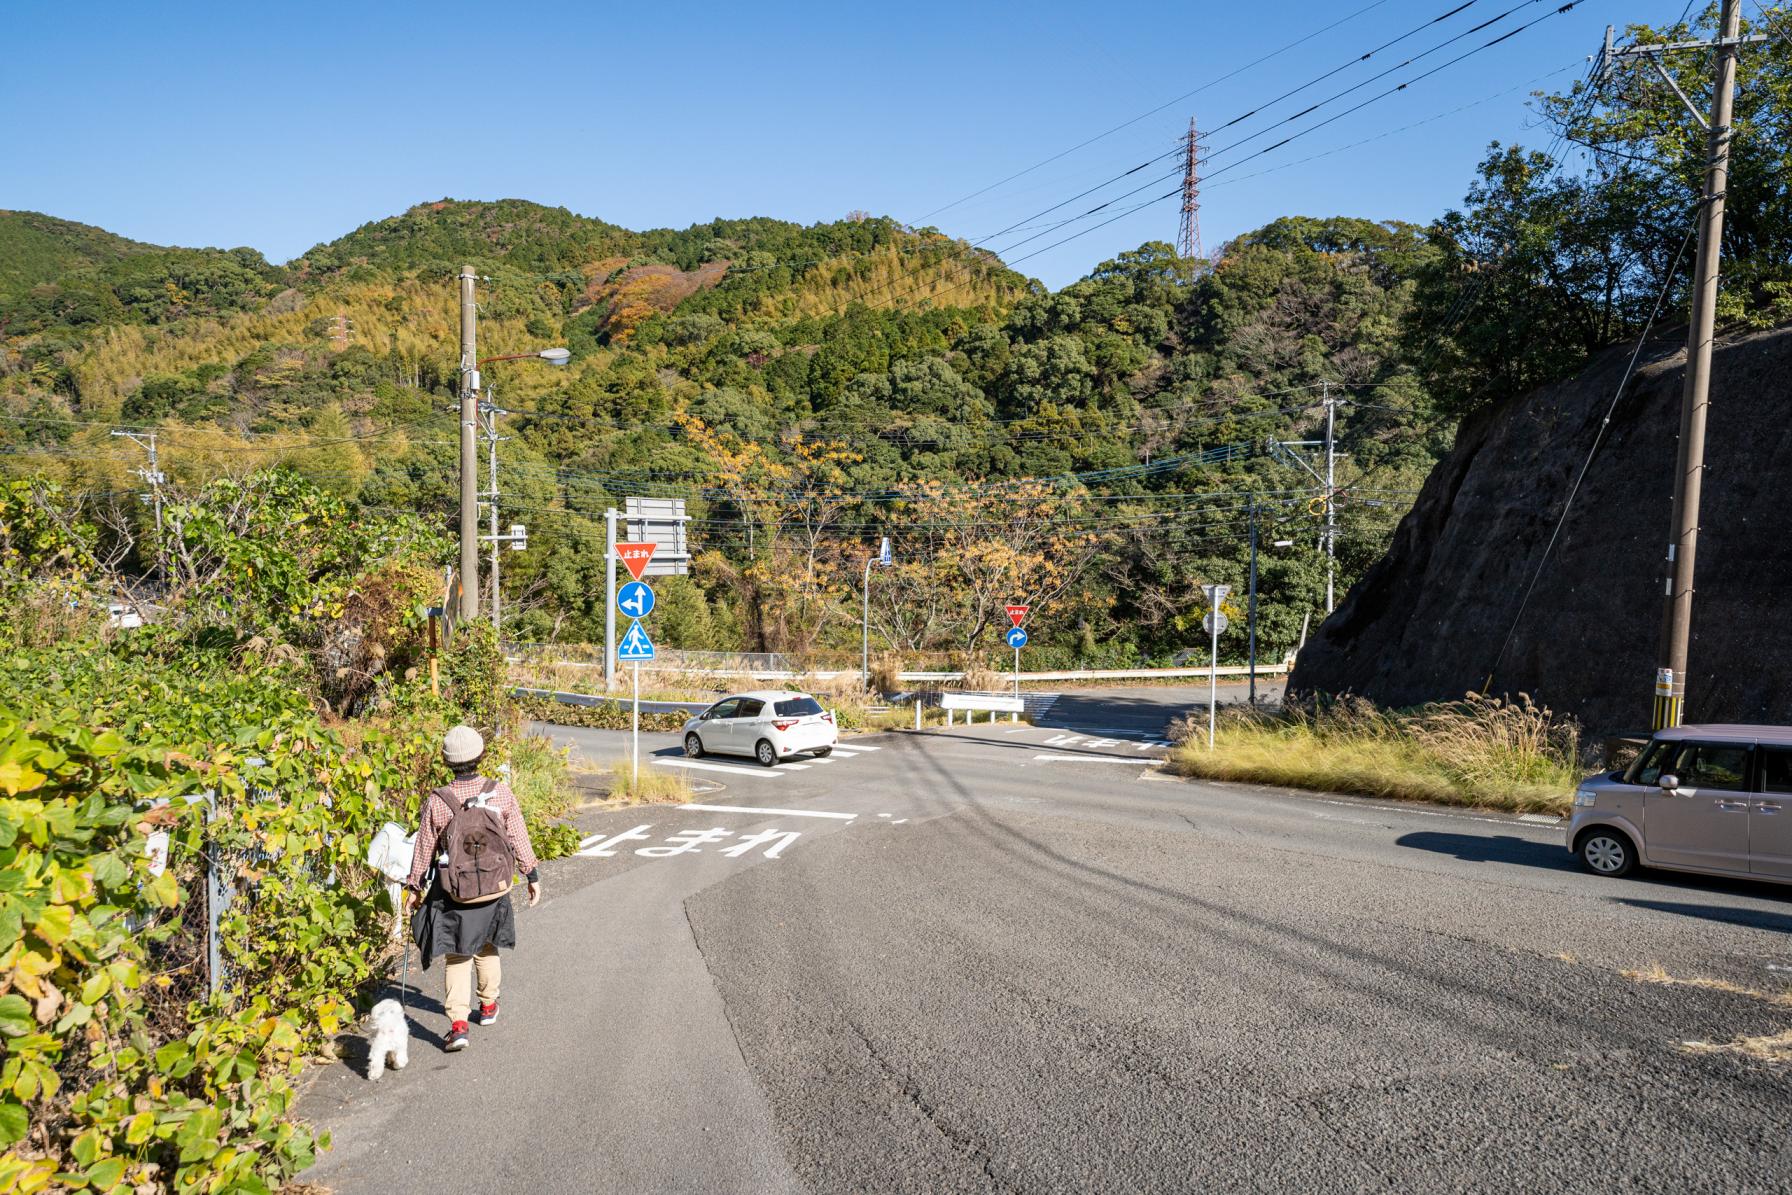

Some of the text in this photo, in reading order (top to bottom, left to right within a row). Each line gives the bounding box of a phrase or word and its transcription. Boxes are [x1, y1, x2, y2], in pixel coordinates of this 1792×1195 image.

[624, 549, 650, 559] 止まれ
[573, 824, 802, 859] 止まれ
